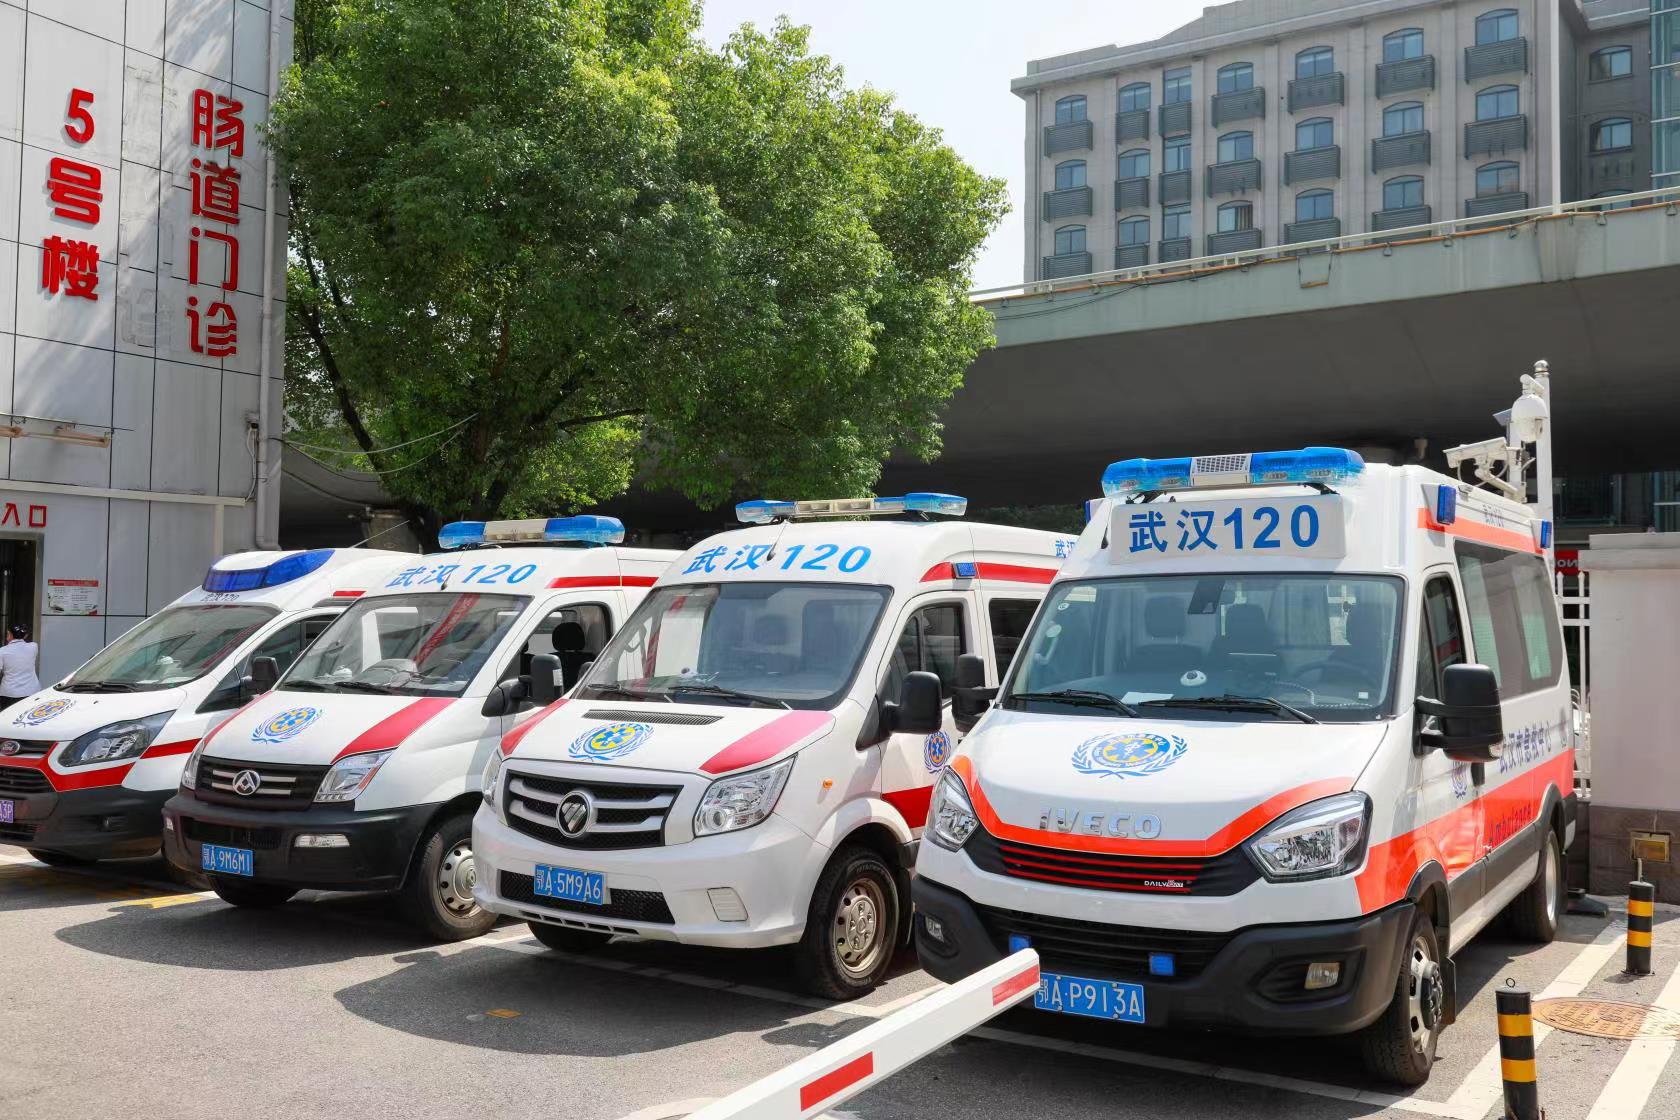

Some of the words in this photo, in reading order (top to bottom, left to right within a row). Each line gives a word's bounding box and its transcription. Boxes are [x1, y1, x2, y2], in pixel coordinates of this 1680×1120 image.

[41, 88, 103, 300] 5号楼
[185, 89, 245, 358] 肠道门诊
[1129, 504, 1319, 553] 武汉120
[385, 564, 537, 588] 武汉120
[681, 544, 872, 575] 武汉120
[1040, 808, 1161, 839] IVECO
